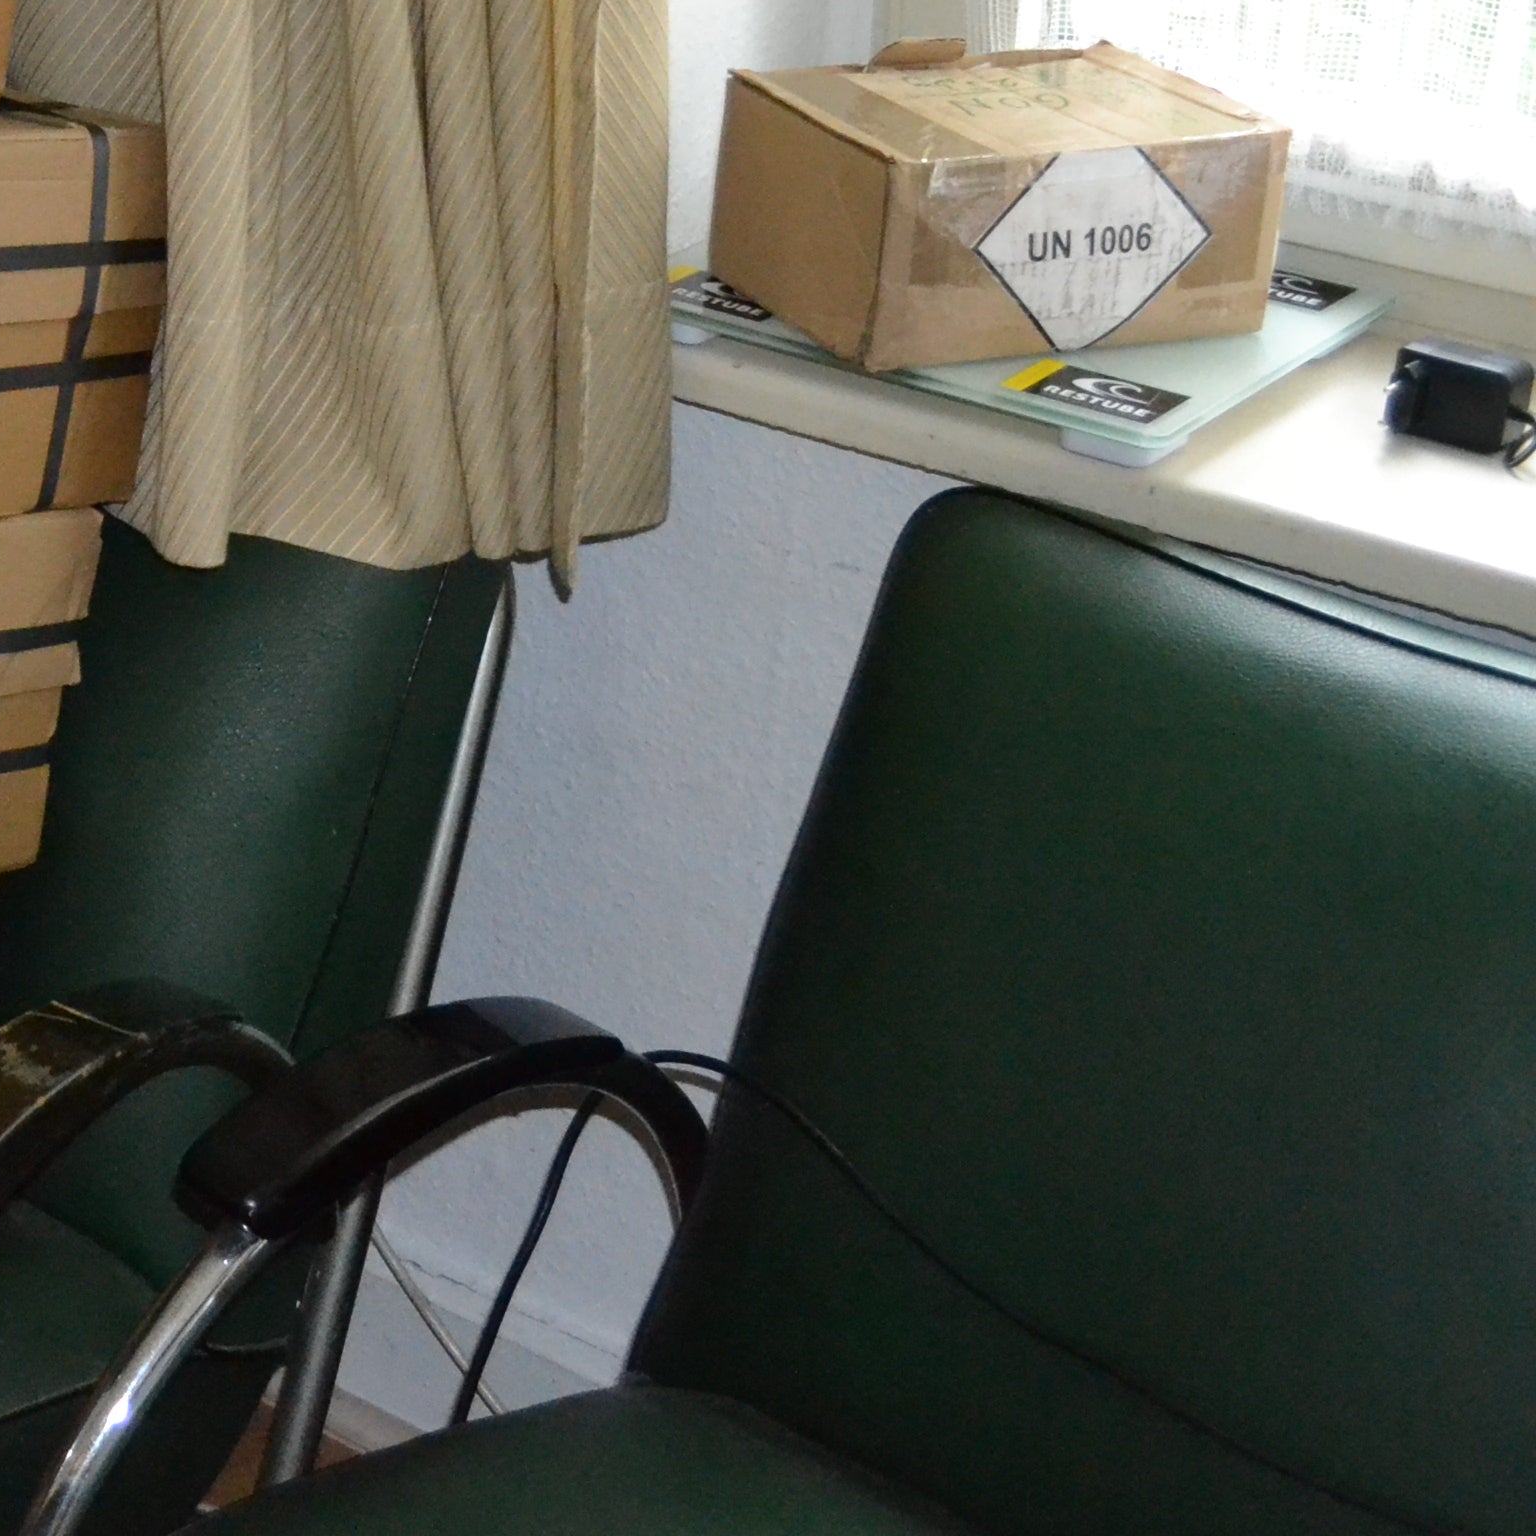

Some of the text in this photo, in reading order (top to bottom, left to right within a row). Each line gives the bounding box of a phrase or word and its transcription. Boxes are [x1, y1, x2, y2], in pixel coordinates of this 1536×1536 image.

[1028, 222, 1153, 262] UN 1006
[1042, 384, 1153, 418] RESTUBE
